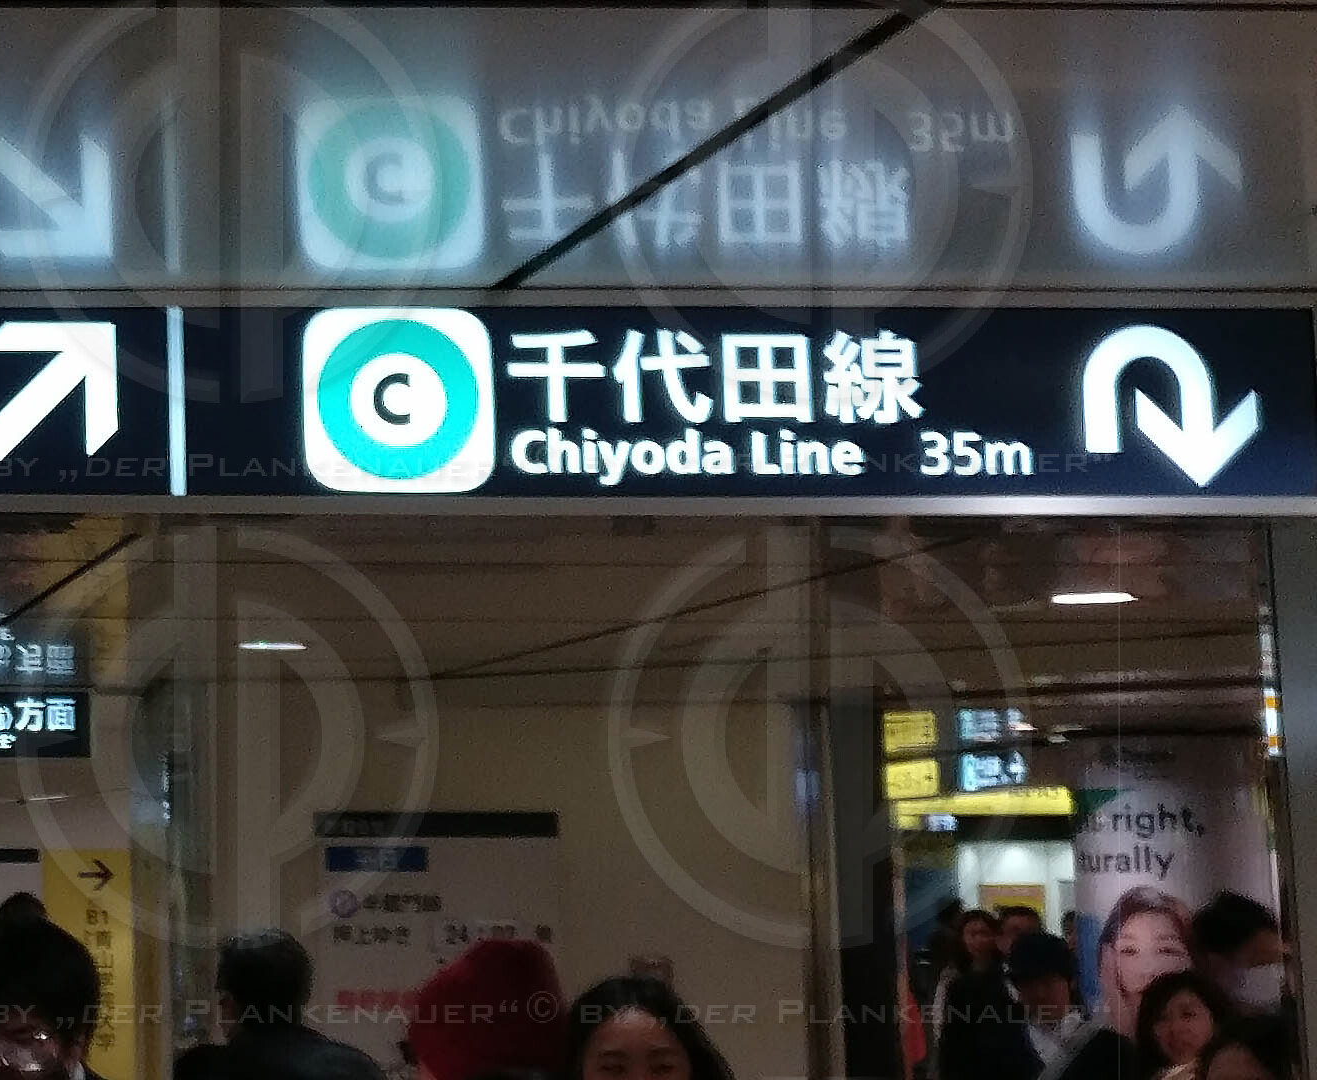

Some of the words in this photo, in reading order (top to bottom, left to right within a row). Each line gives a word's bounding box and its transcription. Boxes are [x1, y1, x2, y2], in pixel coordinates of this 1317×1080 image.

[373, 373, 410, 425] C
[506, 329, 925, 424] 千代田線
[511, 428, 737, 486] Chiyoda
[750, 428, 865, 475] Line
[918, 431, 1037, 476] 35m
